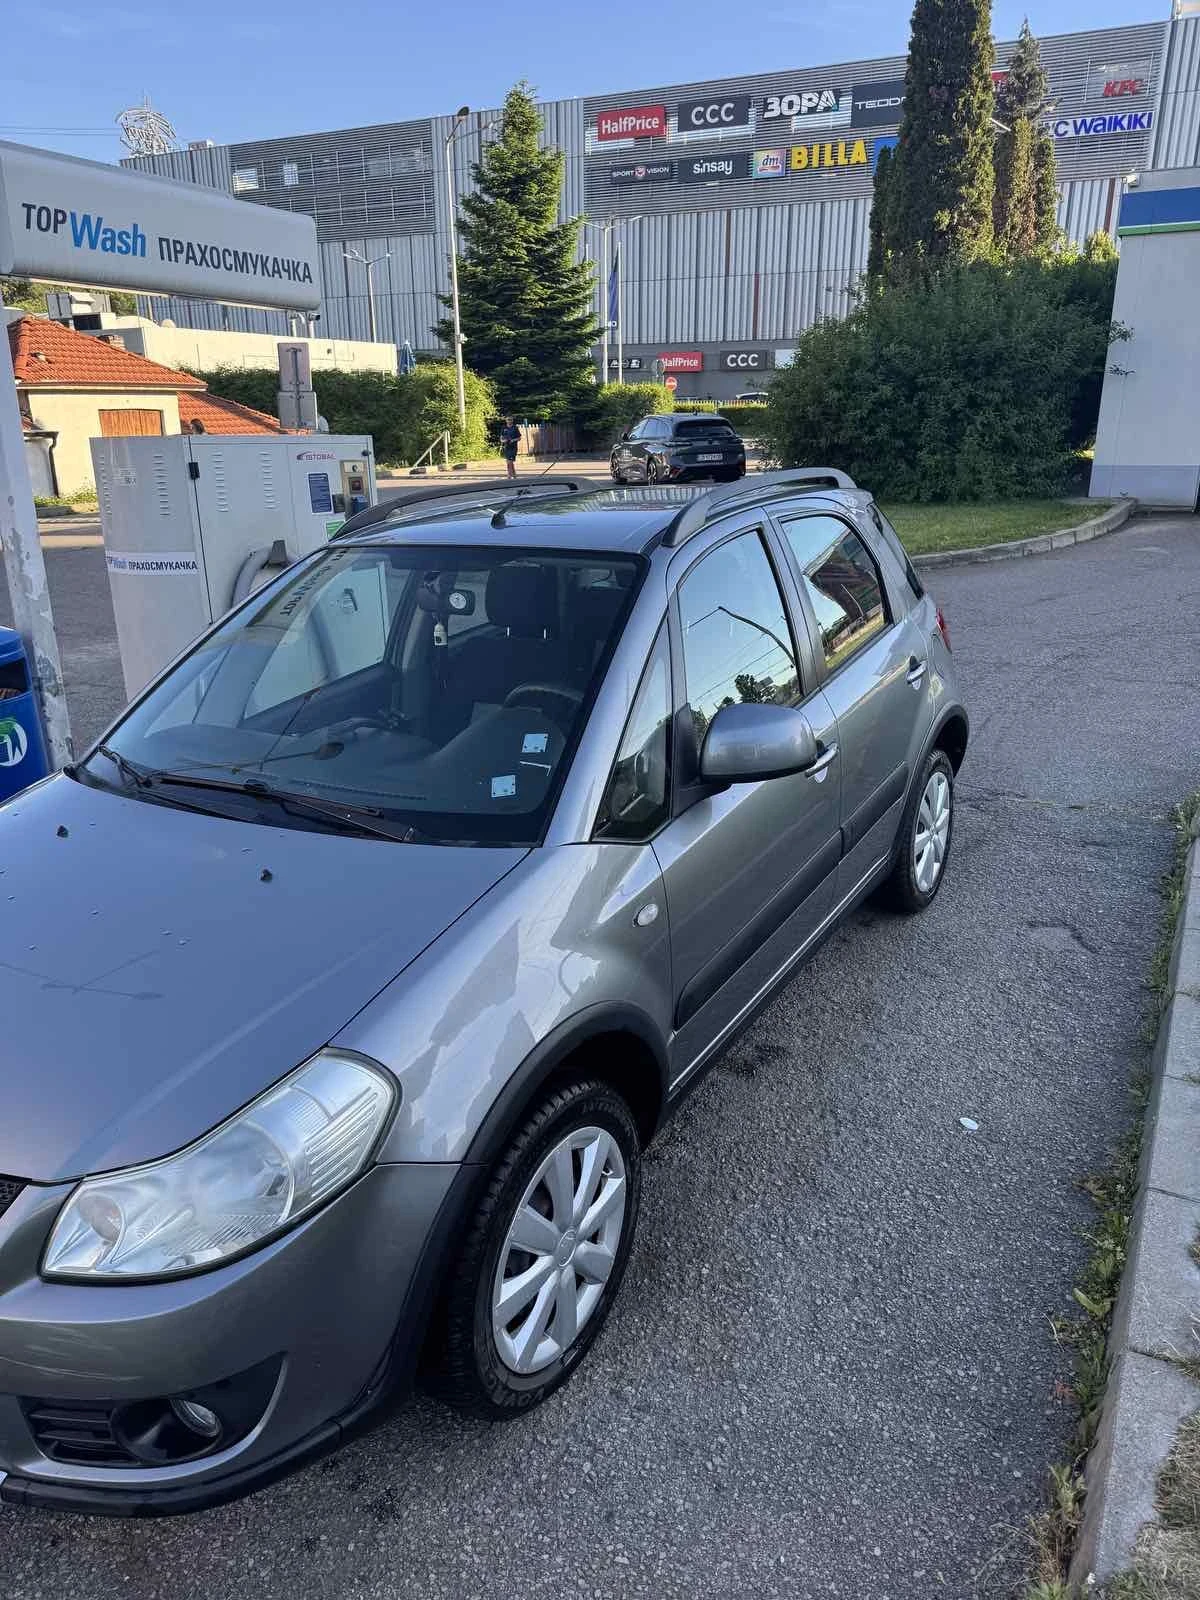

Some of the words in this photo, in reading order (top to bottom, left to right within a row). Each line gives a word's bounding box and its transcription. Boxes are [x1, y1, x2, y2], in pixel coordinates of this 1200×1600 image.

[691, 103, 735, 125] CCC
[602, 116, 659, 135] HalfPrice
[791, 140, 867, 170] BILLA
[612, 170, 635, 178] SPORT
[646, 166, 670, 175] VISION
[693, 159, 733, 175] sinsay
[158, 236, 313, 284] ПРАХОСМУКАЧКА
[726, 354, 759, 367] CCC
[128, 560, 198, 570] ПРАХОСМУКАЧКА
